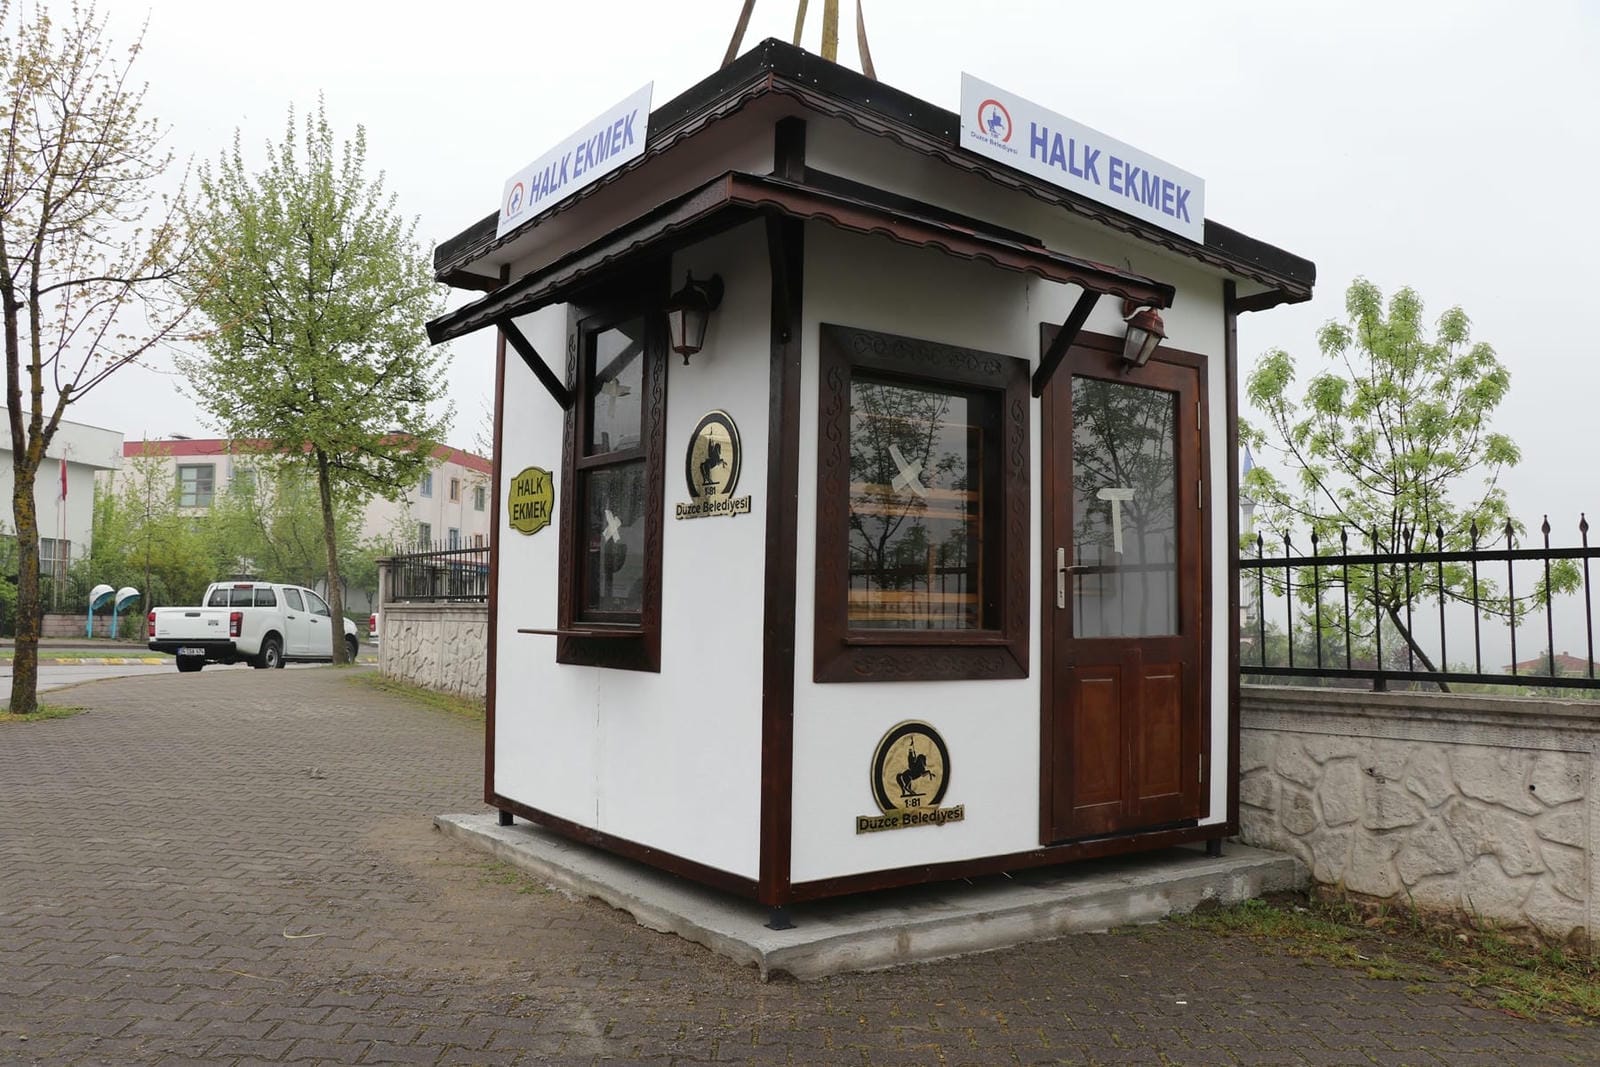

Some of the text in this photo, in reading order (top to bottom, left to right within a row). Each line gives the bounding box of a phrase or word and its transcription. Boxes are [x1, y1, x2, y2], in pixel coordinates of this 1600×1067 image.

[529, 109, 638, 206] HALK EKMEK
[1030, 122, 1191, 224] HALK EKMEK
[513, 477, 547, 521] HALK EKMEK
[703, 497, 748, 512] Belediyesi
[902, 805, 964, 825] Belediyesi
